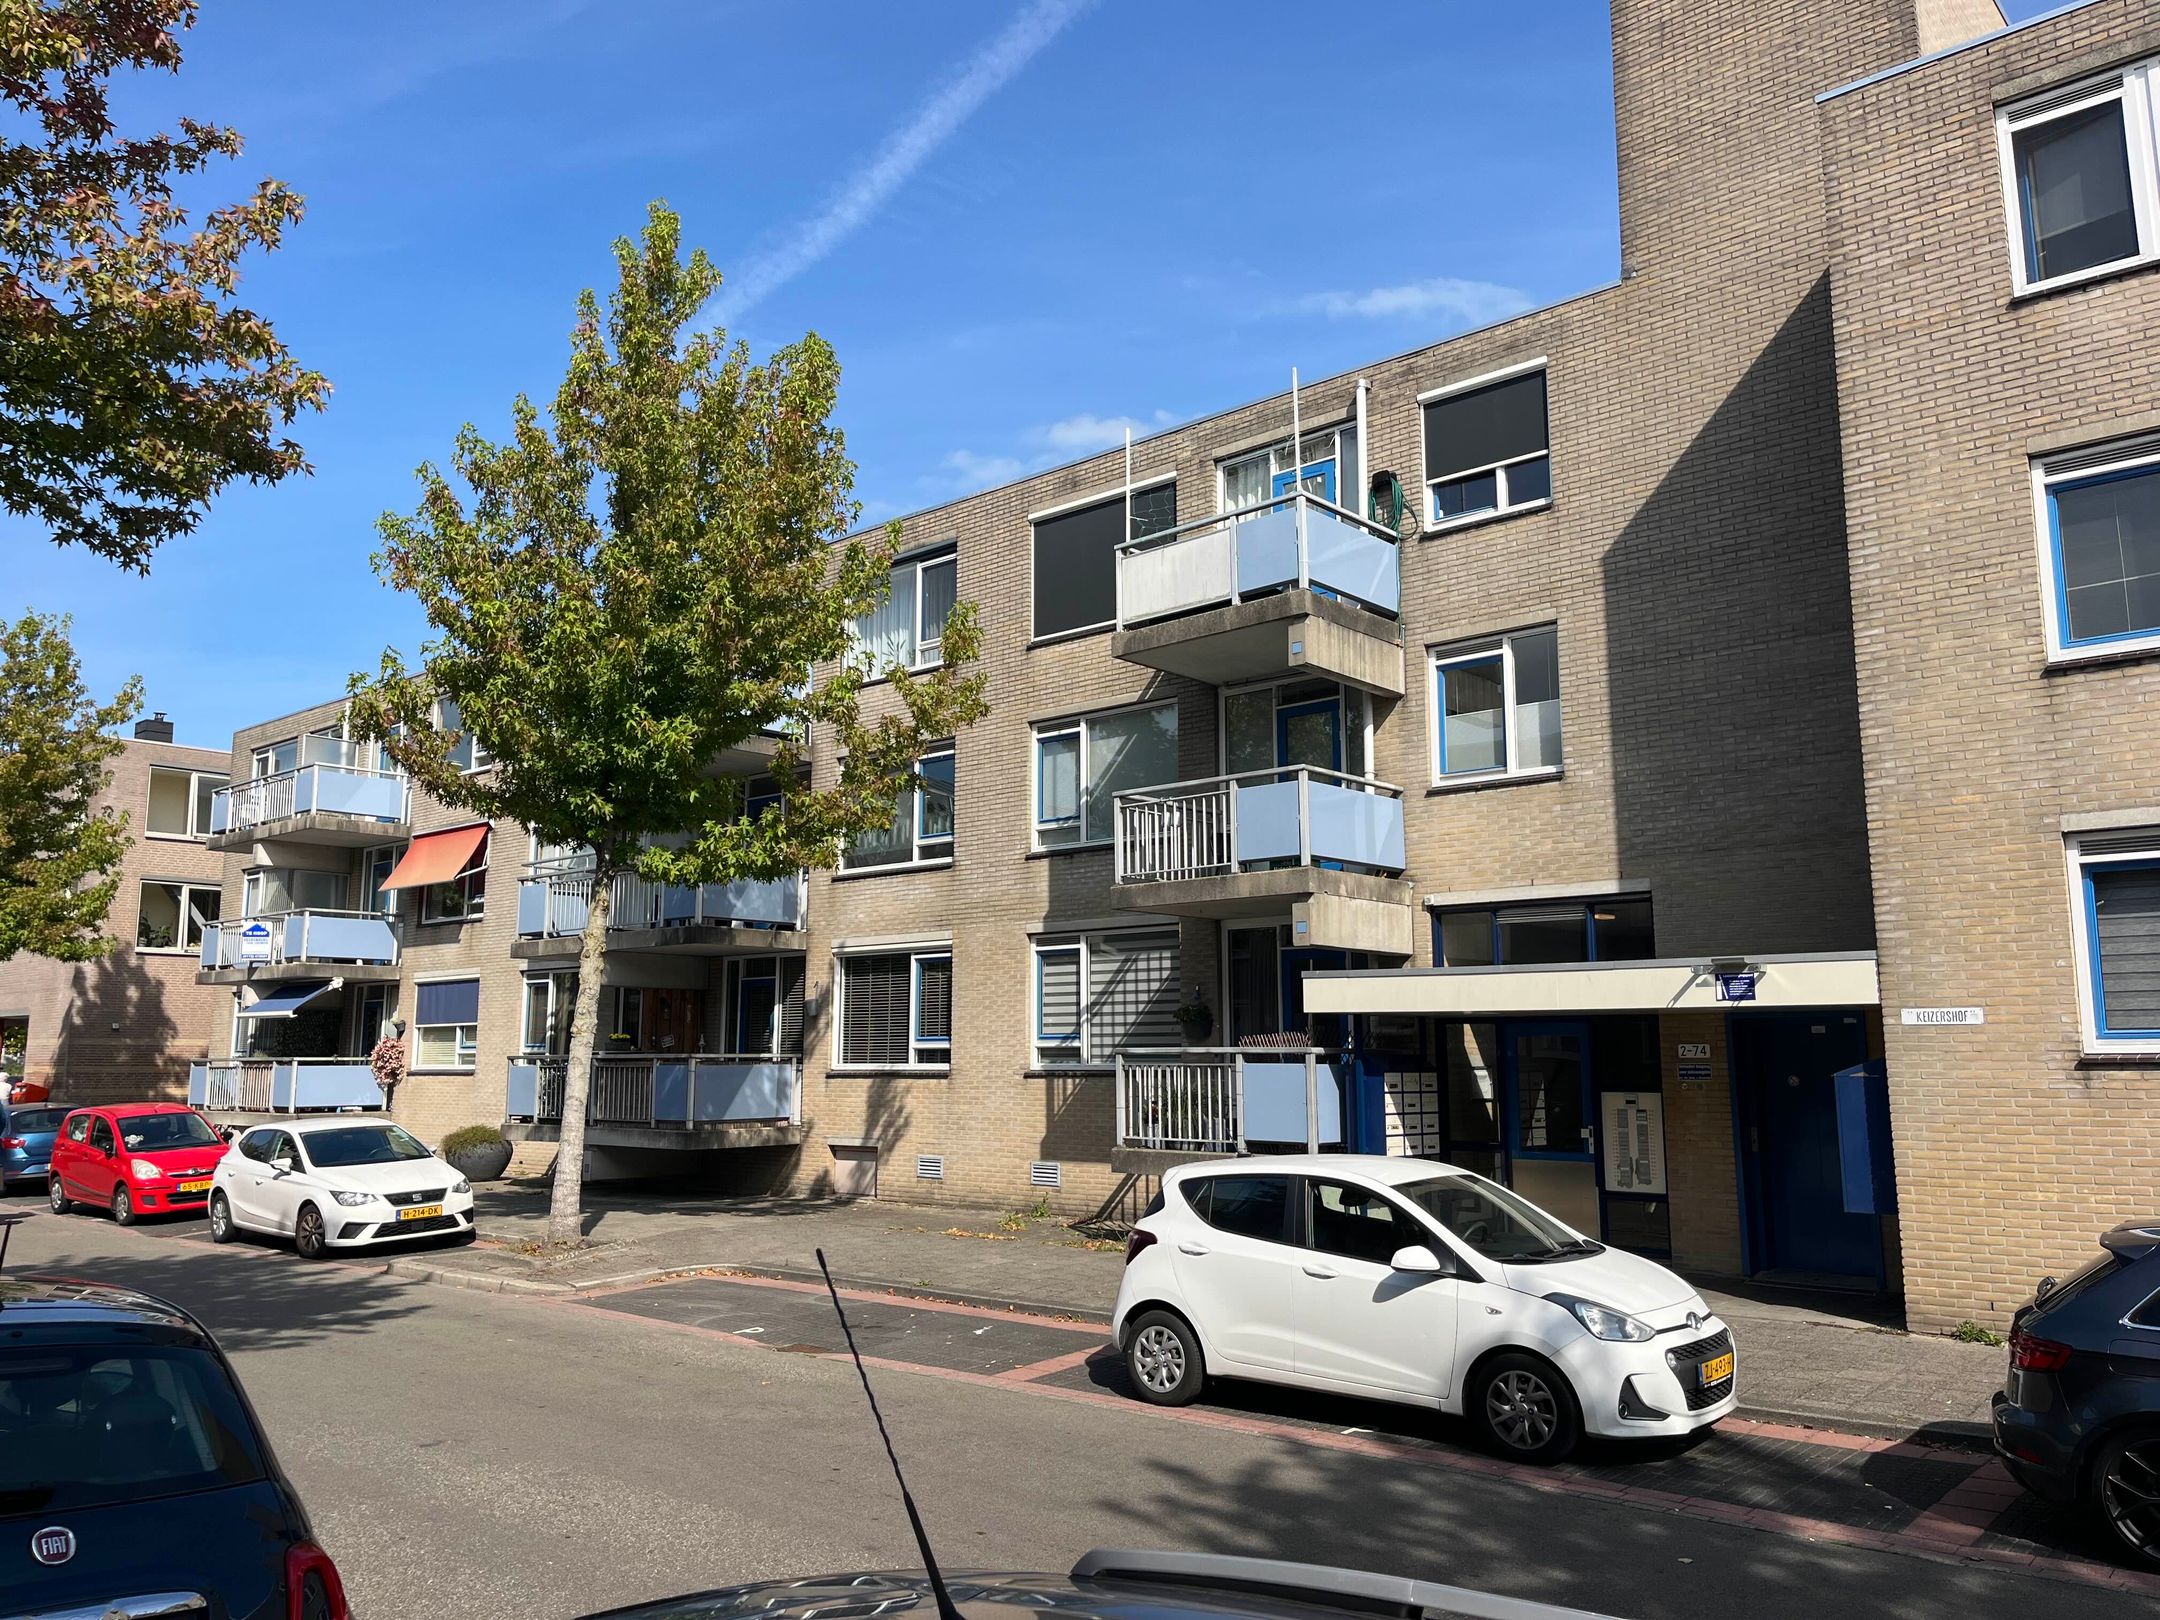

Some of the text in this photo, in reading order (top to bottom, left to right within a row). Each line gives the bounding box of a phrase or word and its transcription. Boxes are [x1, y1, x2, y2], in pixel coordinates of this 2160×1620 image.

[1916, 1010, 1969, 1022] KEIZERSHOF
[1680, 1045, 1707, 1056] 2-74
[403, 1206, 439, 1218] H-214-DK
[41, 1536, 67, 1556] FIAT
